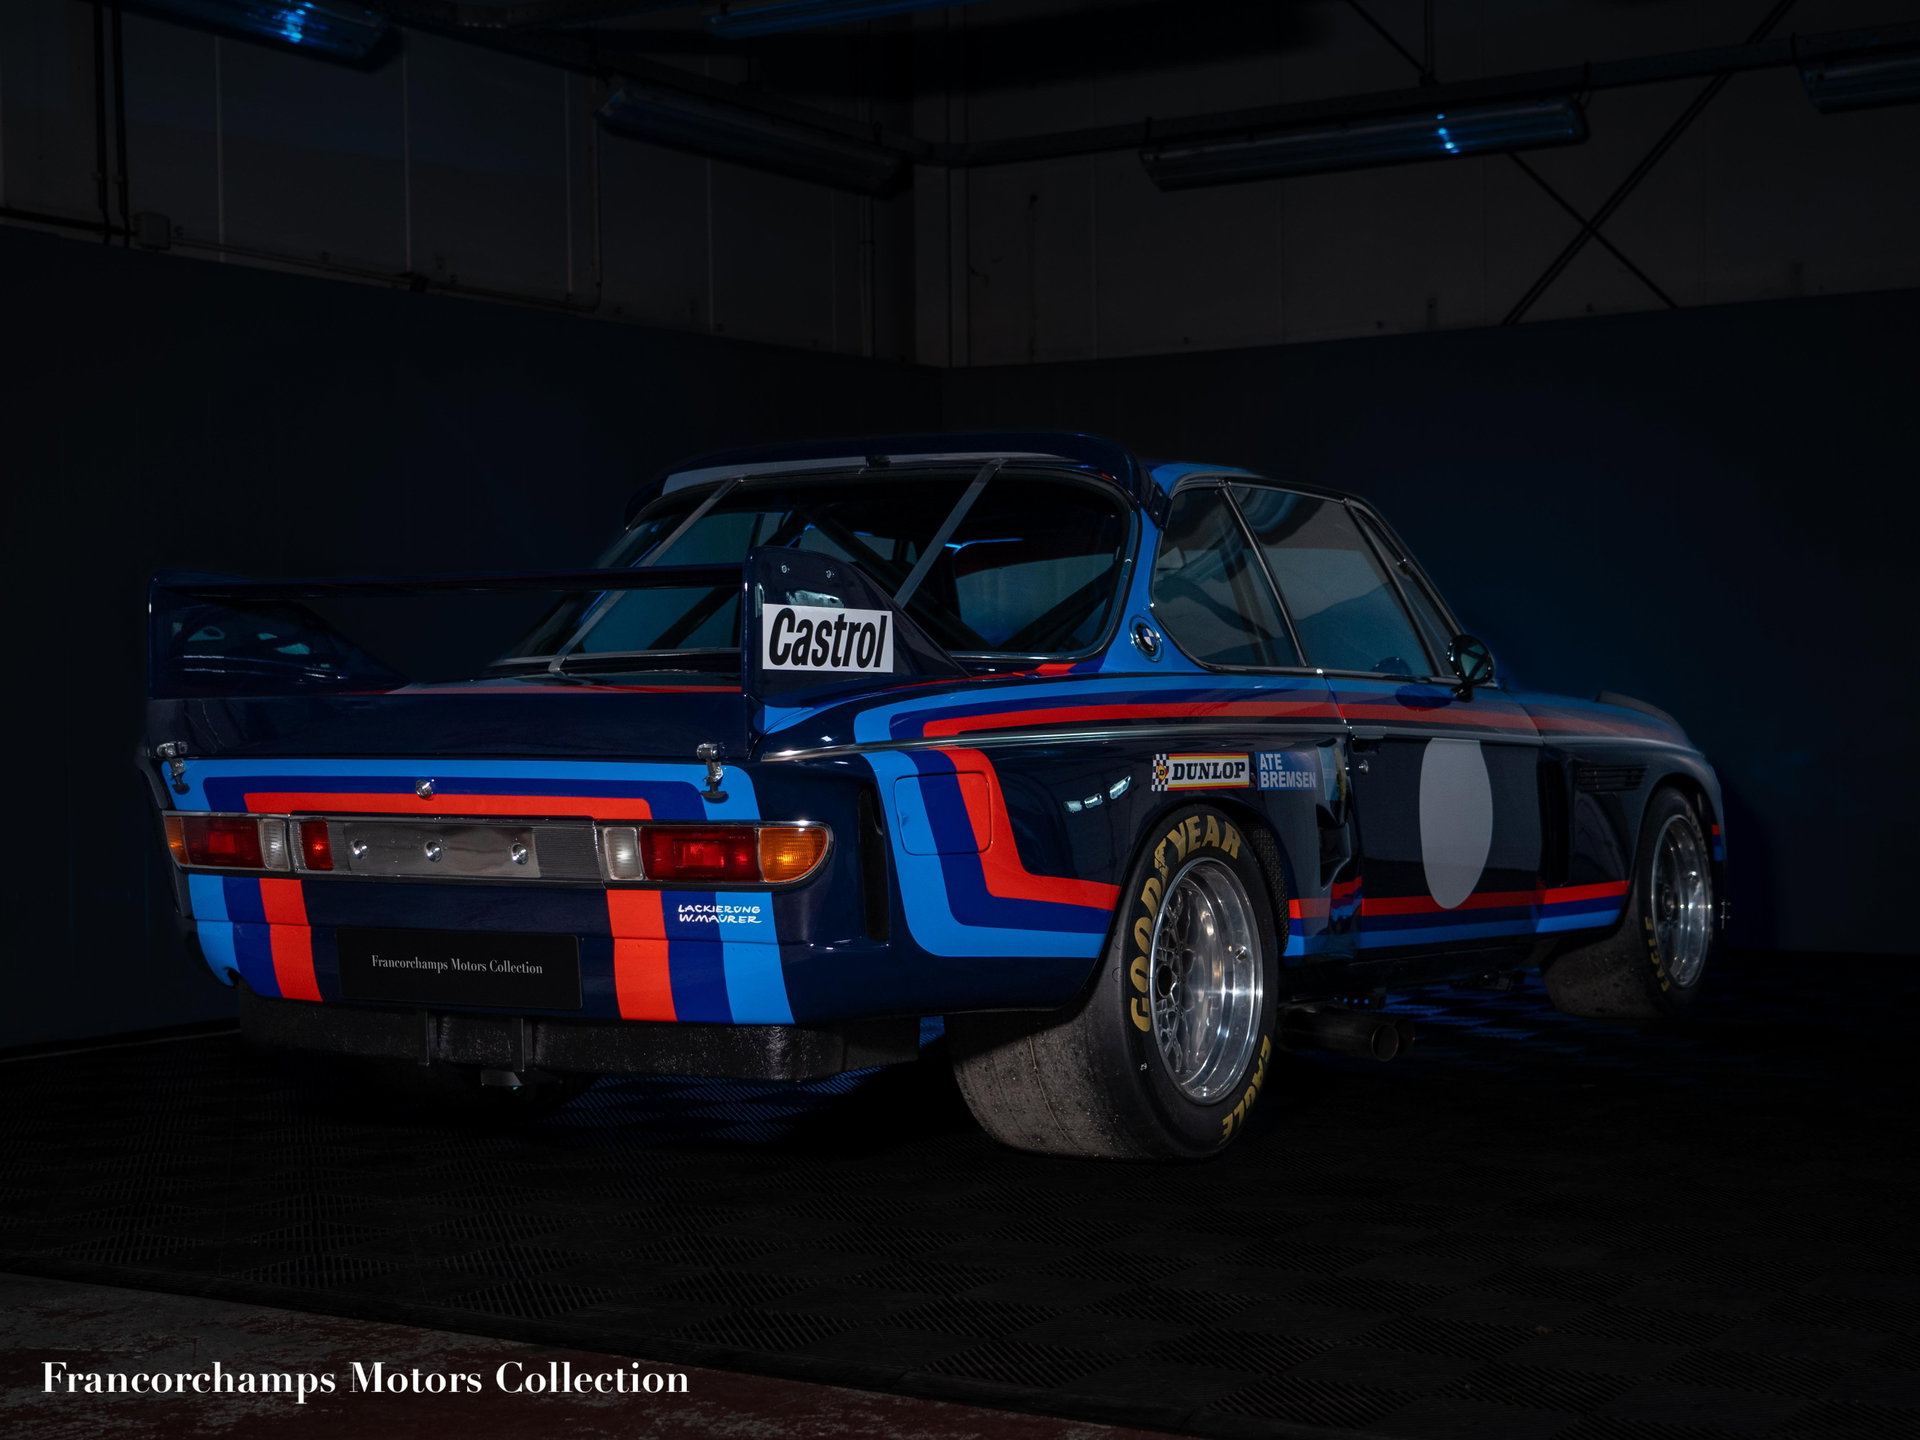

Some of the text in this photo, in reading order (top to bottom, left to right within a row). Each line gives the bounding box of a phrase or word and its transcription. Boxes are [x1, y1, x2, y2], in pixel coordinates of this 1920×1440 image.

[769, 607, 888, 669] Castrol
[1171, 761, 1246, 781] DUNLOP
[1260, 753, 1283, 770] ATE
[1260, 771, 1317, 788] BREMSEN
[371, 954, 543, 974] Francorchamps Motors Collection
[1217, 1033, 1273, 1145] EAGLE
